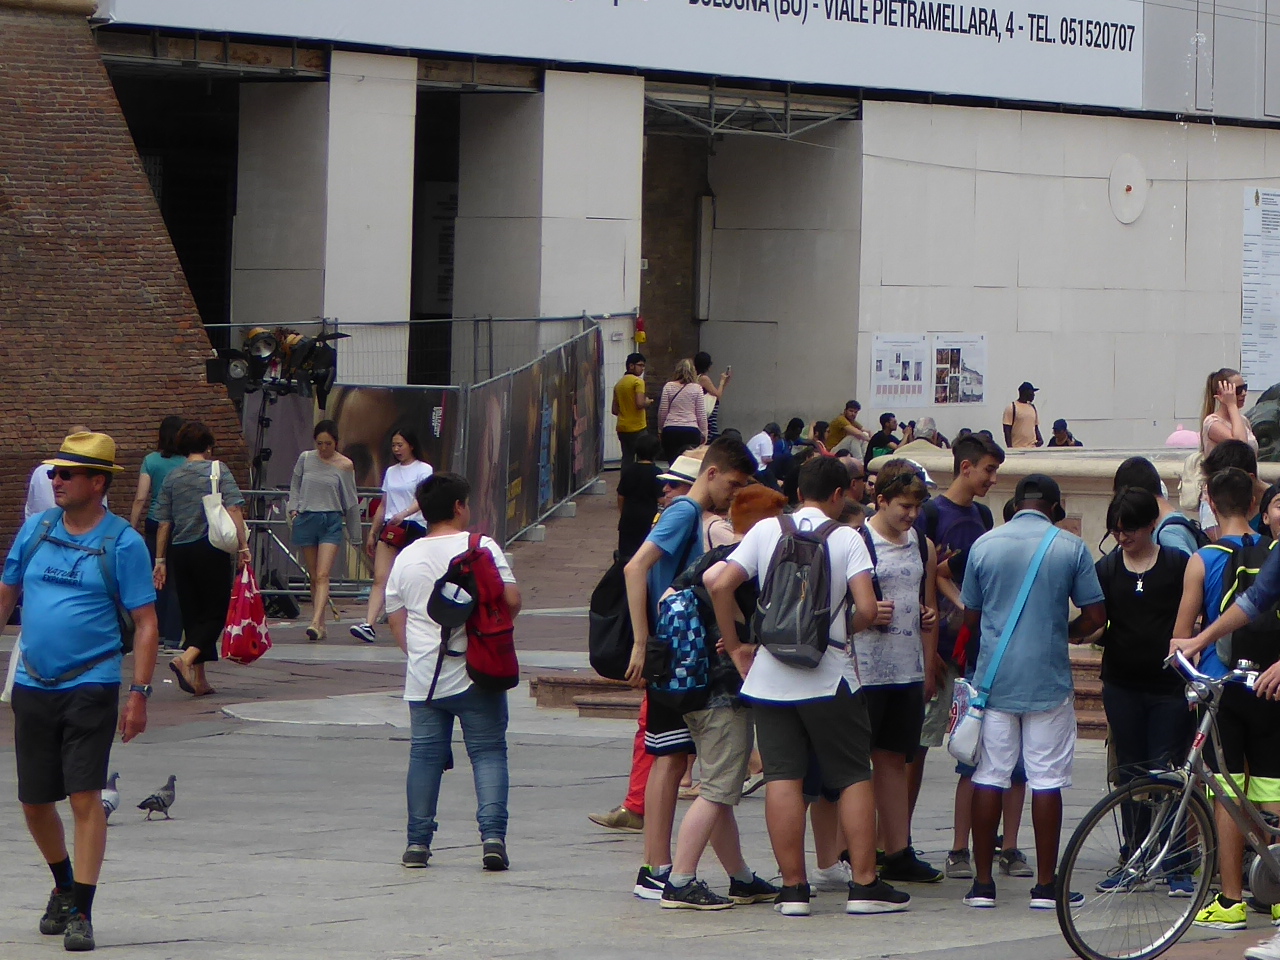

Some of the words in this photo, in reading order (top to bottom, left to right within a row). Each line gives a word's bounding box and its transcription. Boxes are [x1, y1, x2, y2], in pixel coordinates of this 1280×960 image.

[1005, 11, 1014, 39] 4
[1028, 13, 1056, 44] TEL.
[1060, 17, 1135, 52] 051520707
